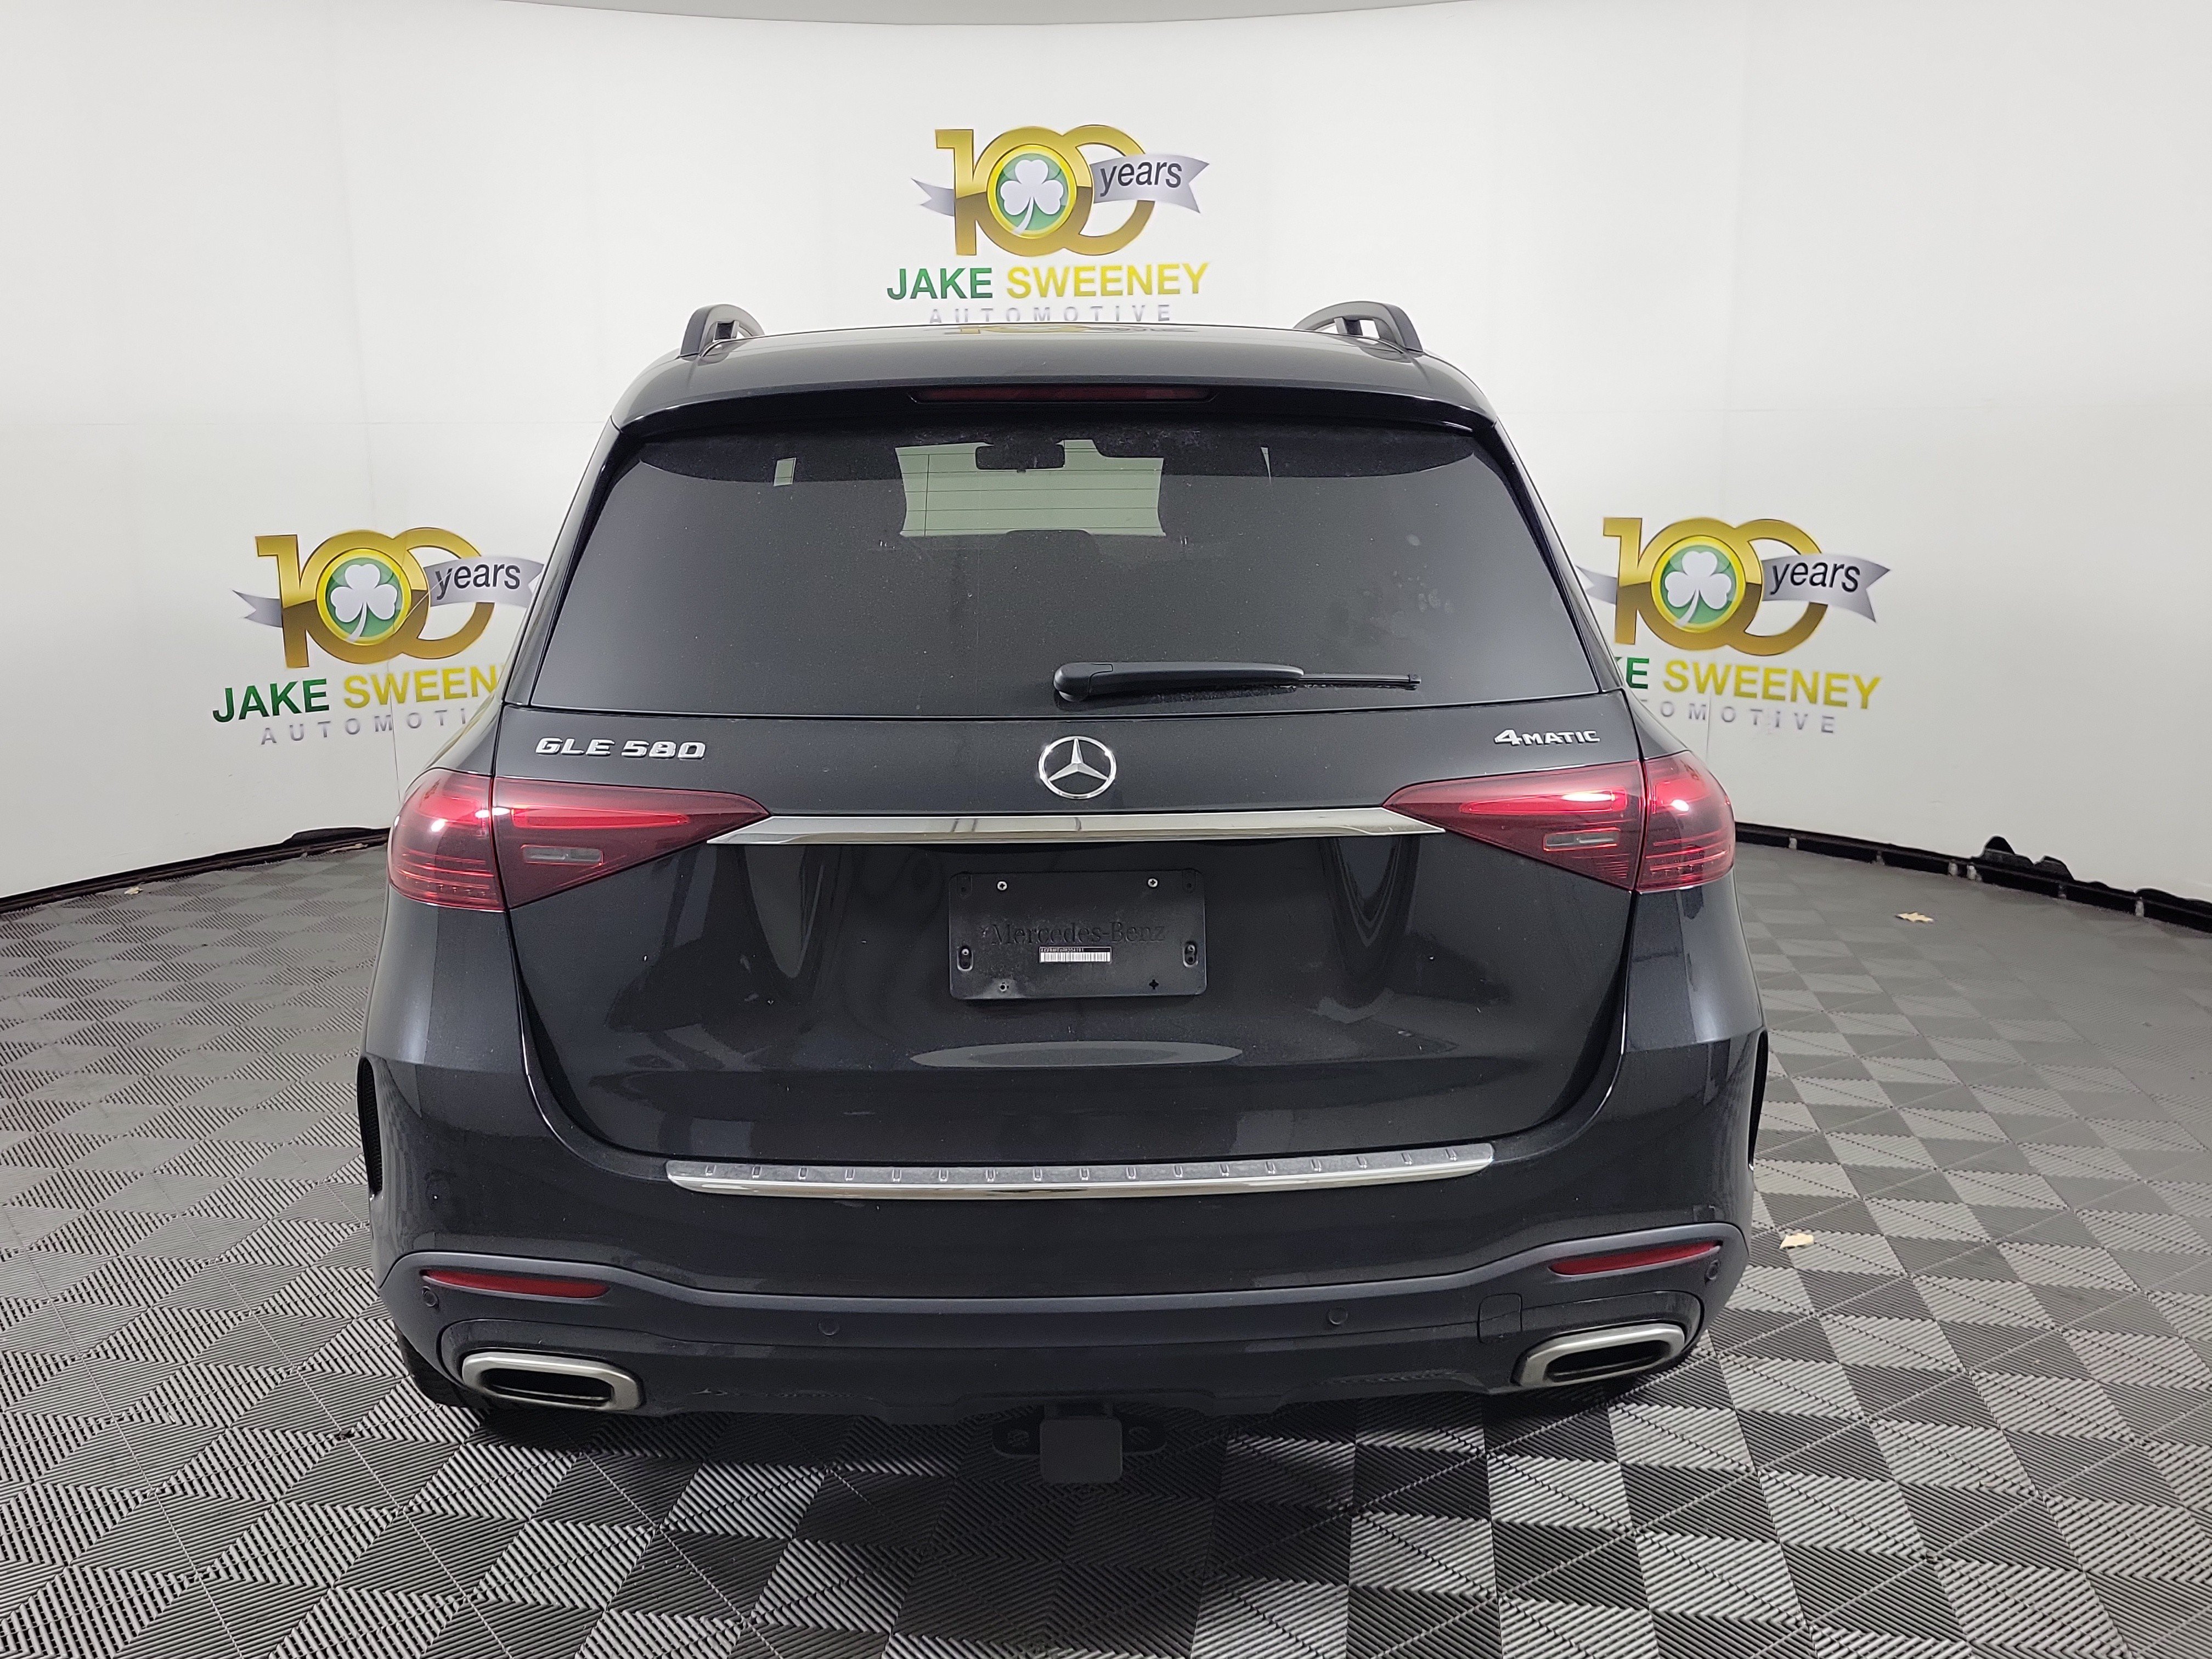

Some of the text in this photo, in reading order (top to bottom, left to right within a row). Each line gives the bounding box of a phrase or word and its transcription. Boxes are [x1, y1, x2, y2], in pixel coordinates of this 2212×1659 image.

[935, 124, 1182, 257] 100 years
[887, 262, 1210, 300] JAKE SWEENEY
[929, 304, 1170, 324] AUTOMOTIVE
[255, 527, 521, 668] 100 years
[1602, 517, 1860, 656] 100 years
[212, 663, 504, 723] JAKE SWEEN
[1663, 661, 1882, 709] SWEENEY
[1640, 699, 1835, 734] OMOTIVE
[535, 737, 706, 759] GLE 580
[1494, 729, 1600, 745] 4MATIC
[982, 921, 1165, 945] Mercedes-Benz
